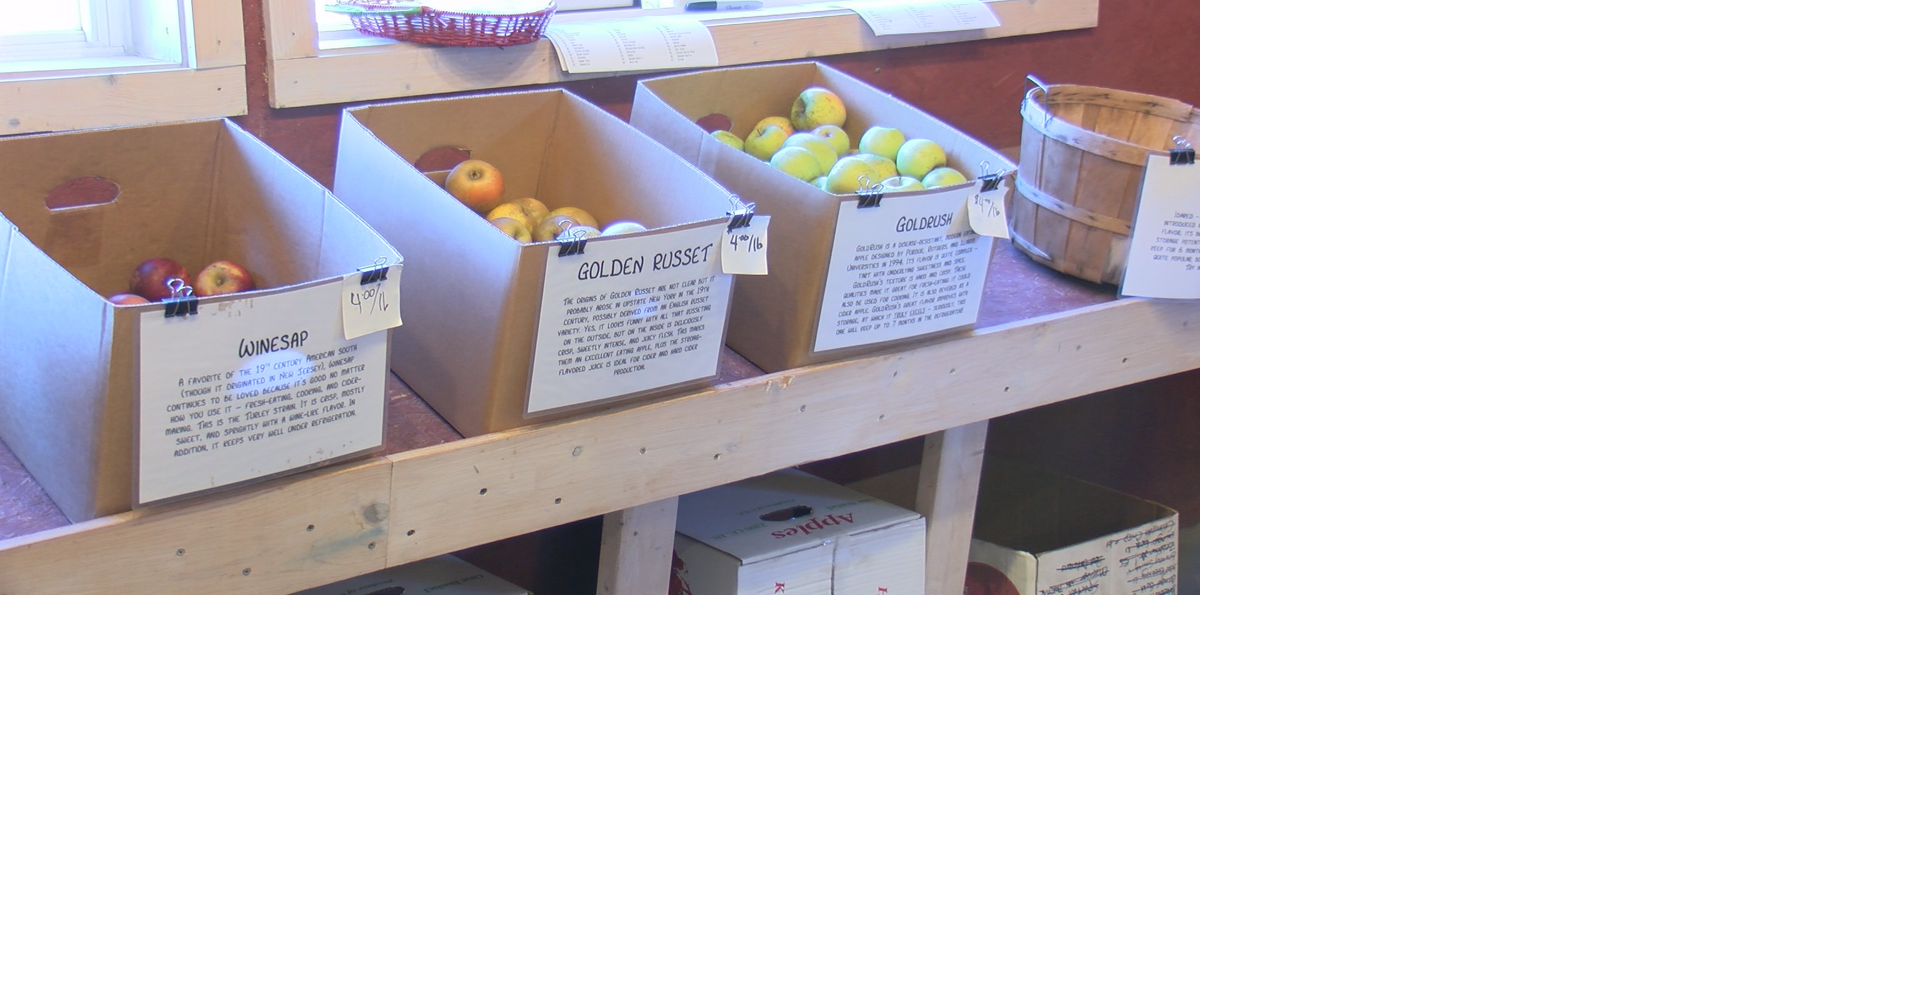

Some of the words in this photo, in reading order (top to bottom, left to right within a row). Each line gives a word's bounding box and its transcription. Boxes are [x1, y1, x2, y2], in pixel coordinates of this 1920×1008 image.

[578, 255, 645, 281] GOLDEN
[653, 243, 714, 272] RUSSET
[239, 330, 309, 359] WINESAP
[771, 513, 854, 539] Apples
